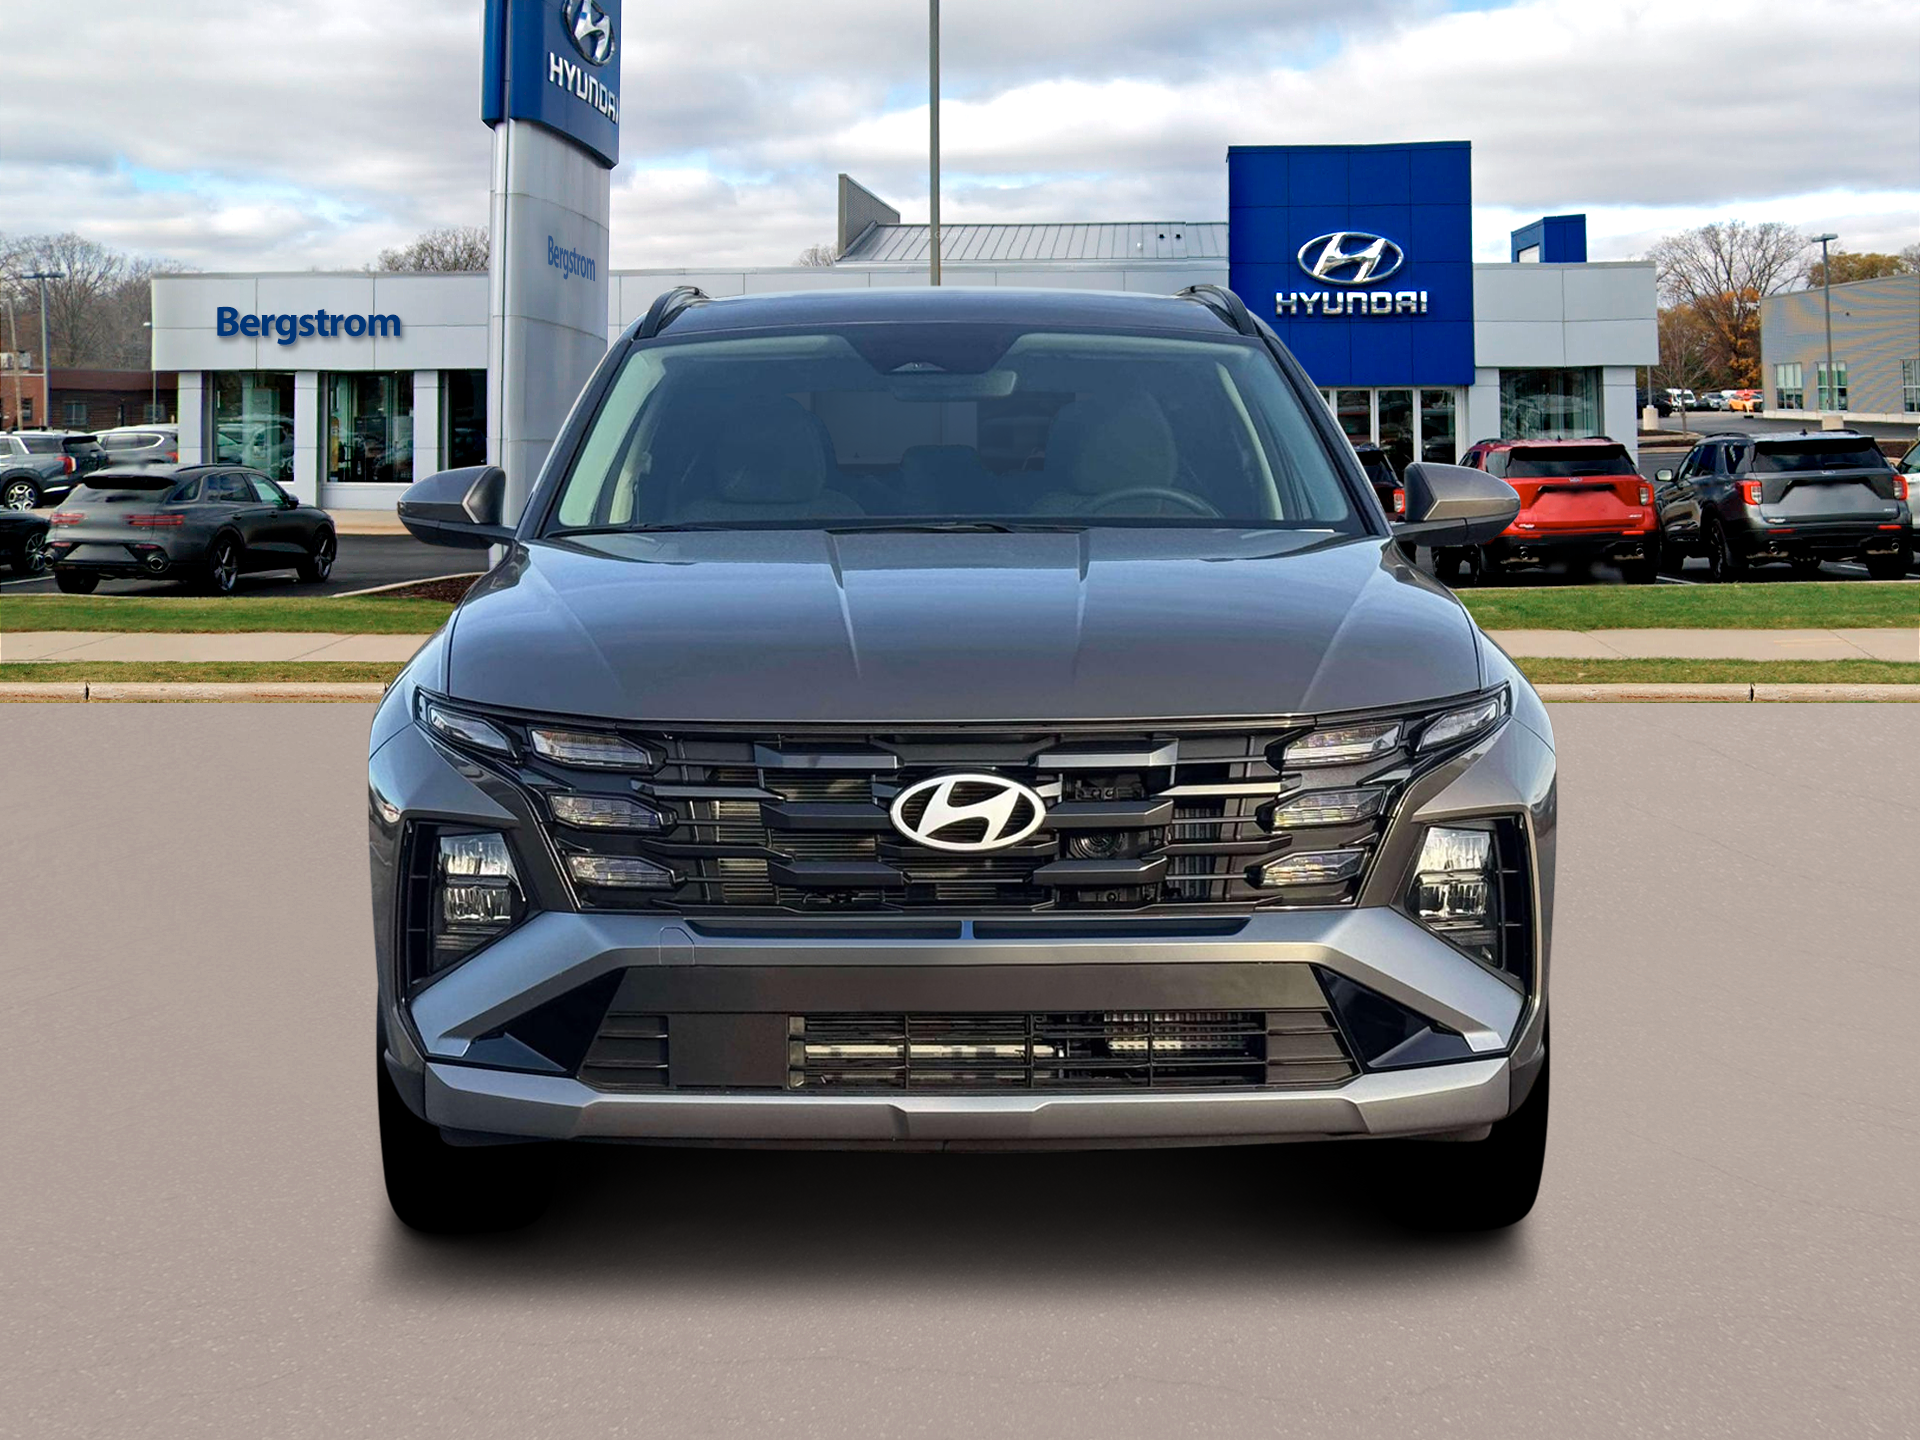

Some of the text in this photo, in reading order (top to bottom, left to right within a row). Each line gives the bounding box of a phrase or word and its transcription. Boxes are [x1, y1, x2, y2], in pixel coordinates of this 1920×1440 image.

[549, 52, 619, 124] HYUNDAI
[547, 235, 596, 282] Bergstrom
[1276, 290, 1429, 315] HYUNDAI
[217, 306, 402, 346] Bergstrom
